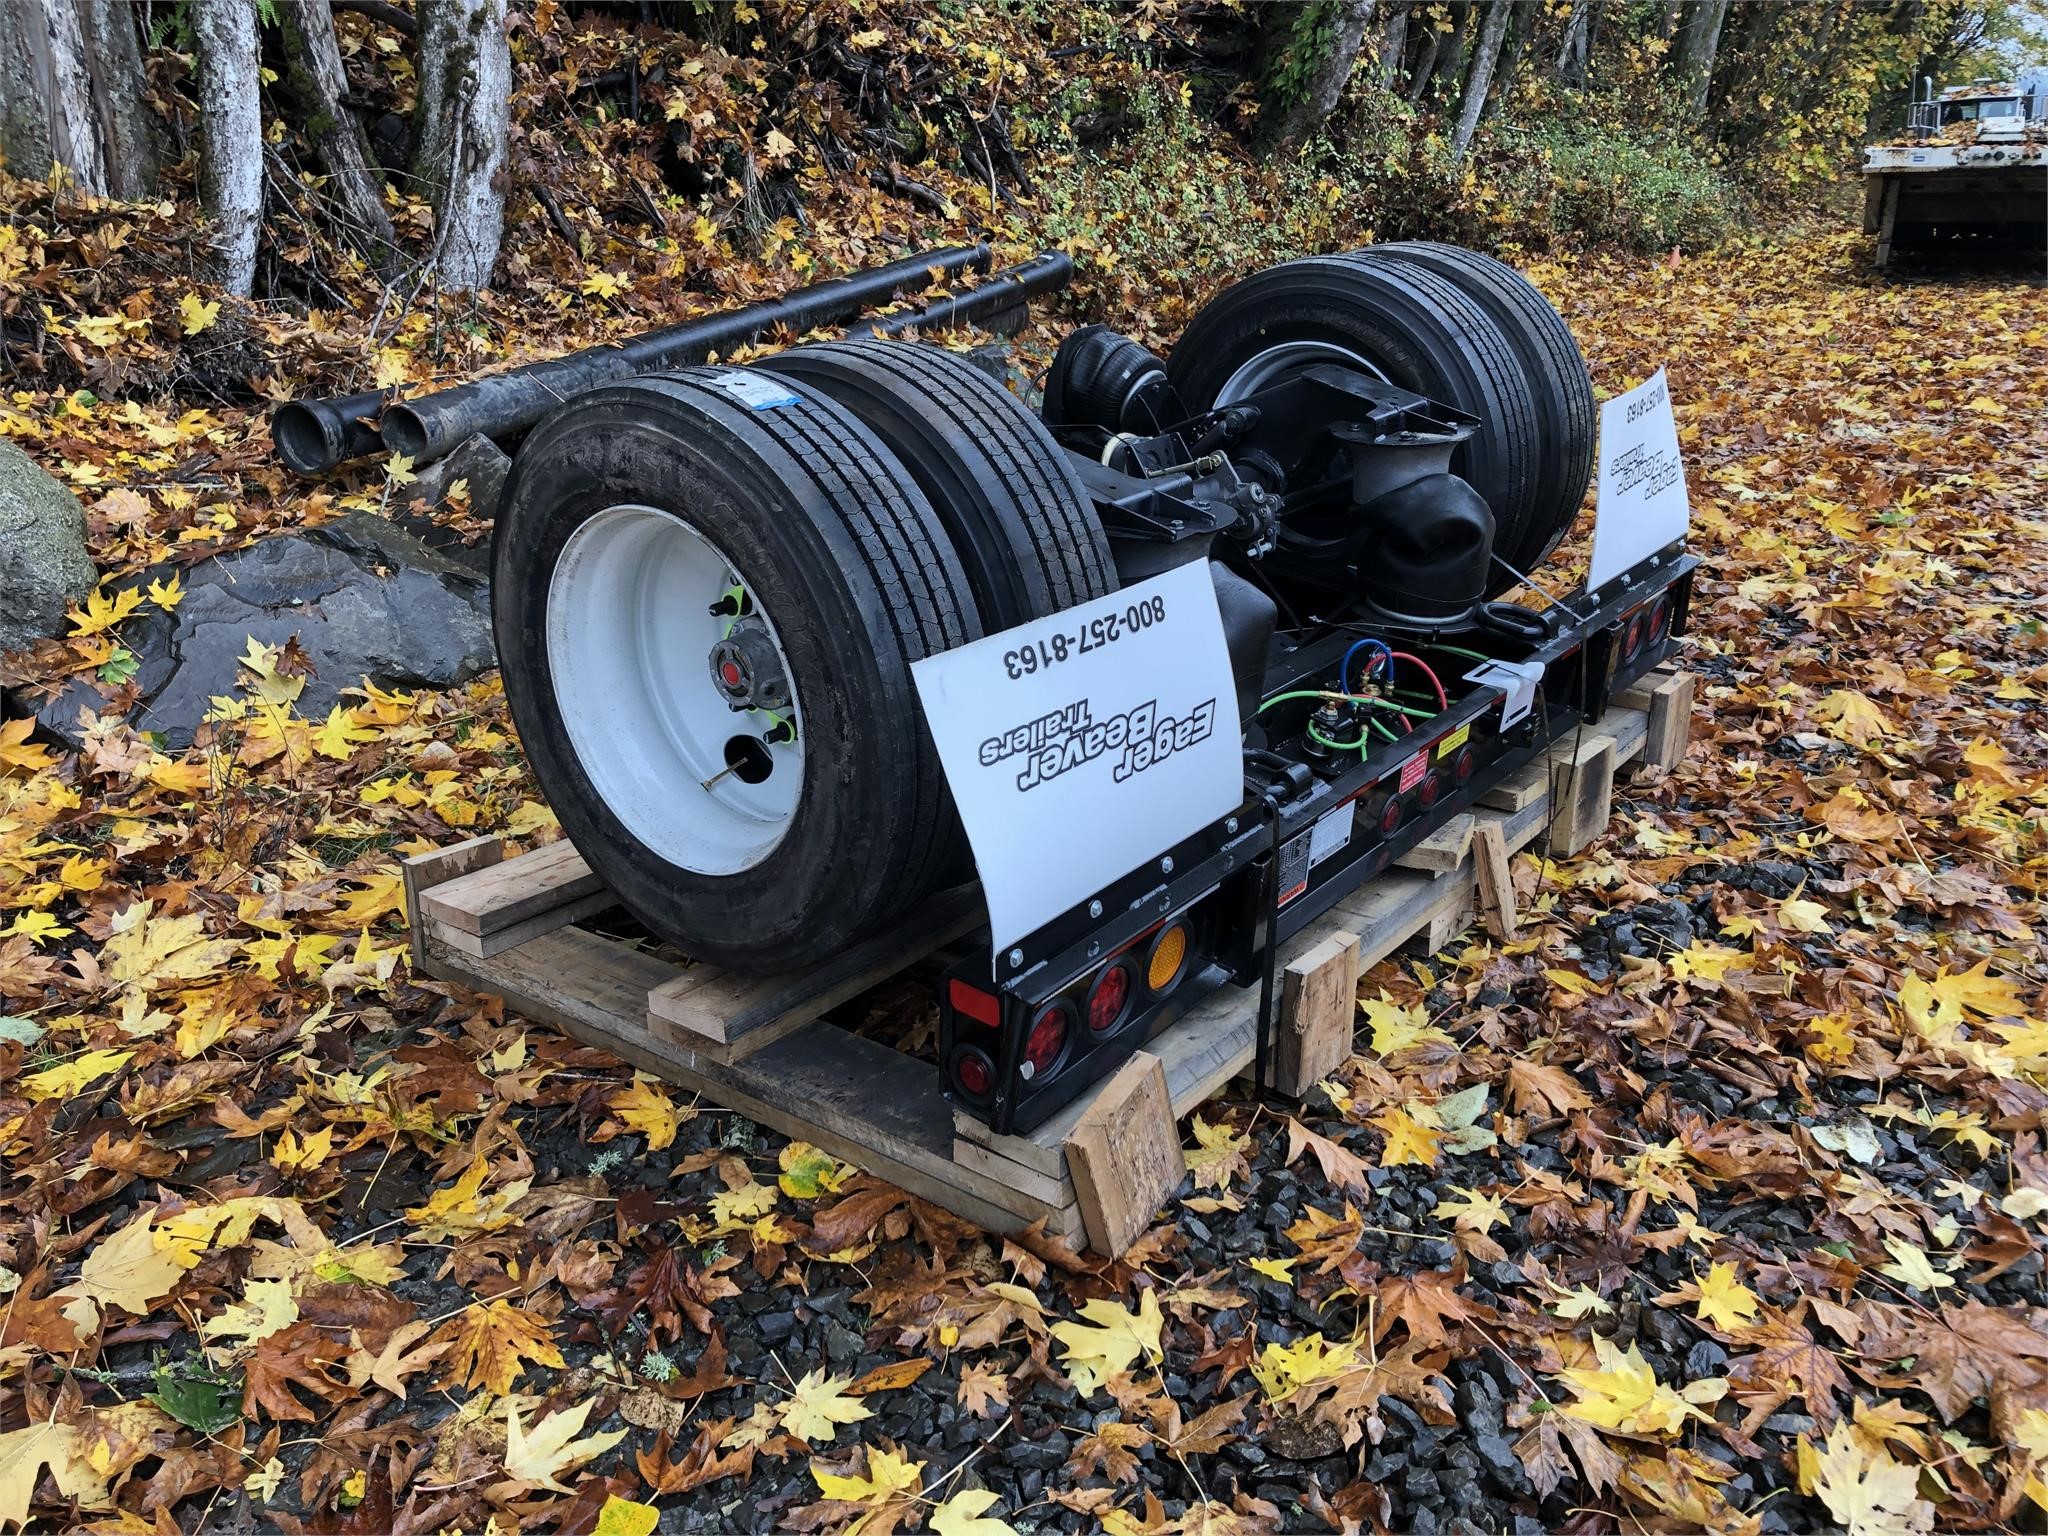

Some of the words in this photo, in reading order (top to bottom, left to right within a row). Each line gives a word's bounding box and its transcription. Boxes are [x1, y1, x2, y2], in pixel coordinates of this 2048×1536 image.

[1617, 450, 1663, 496] Beaver
[1645, 456, 1679, 500] Eager
[1003, 595, 1165, 680] 800-257-8163
[979, 699, 1092, 767] Trailers
[1017, 698, 1156, 792] Beaver
[1113, 698, 1216, 783] Eager
